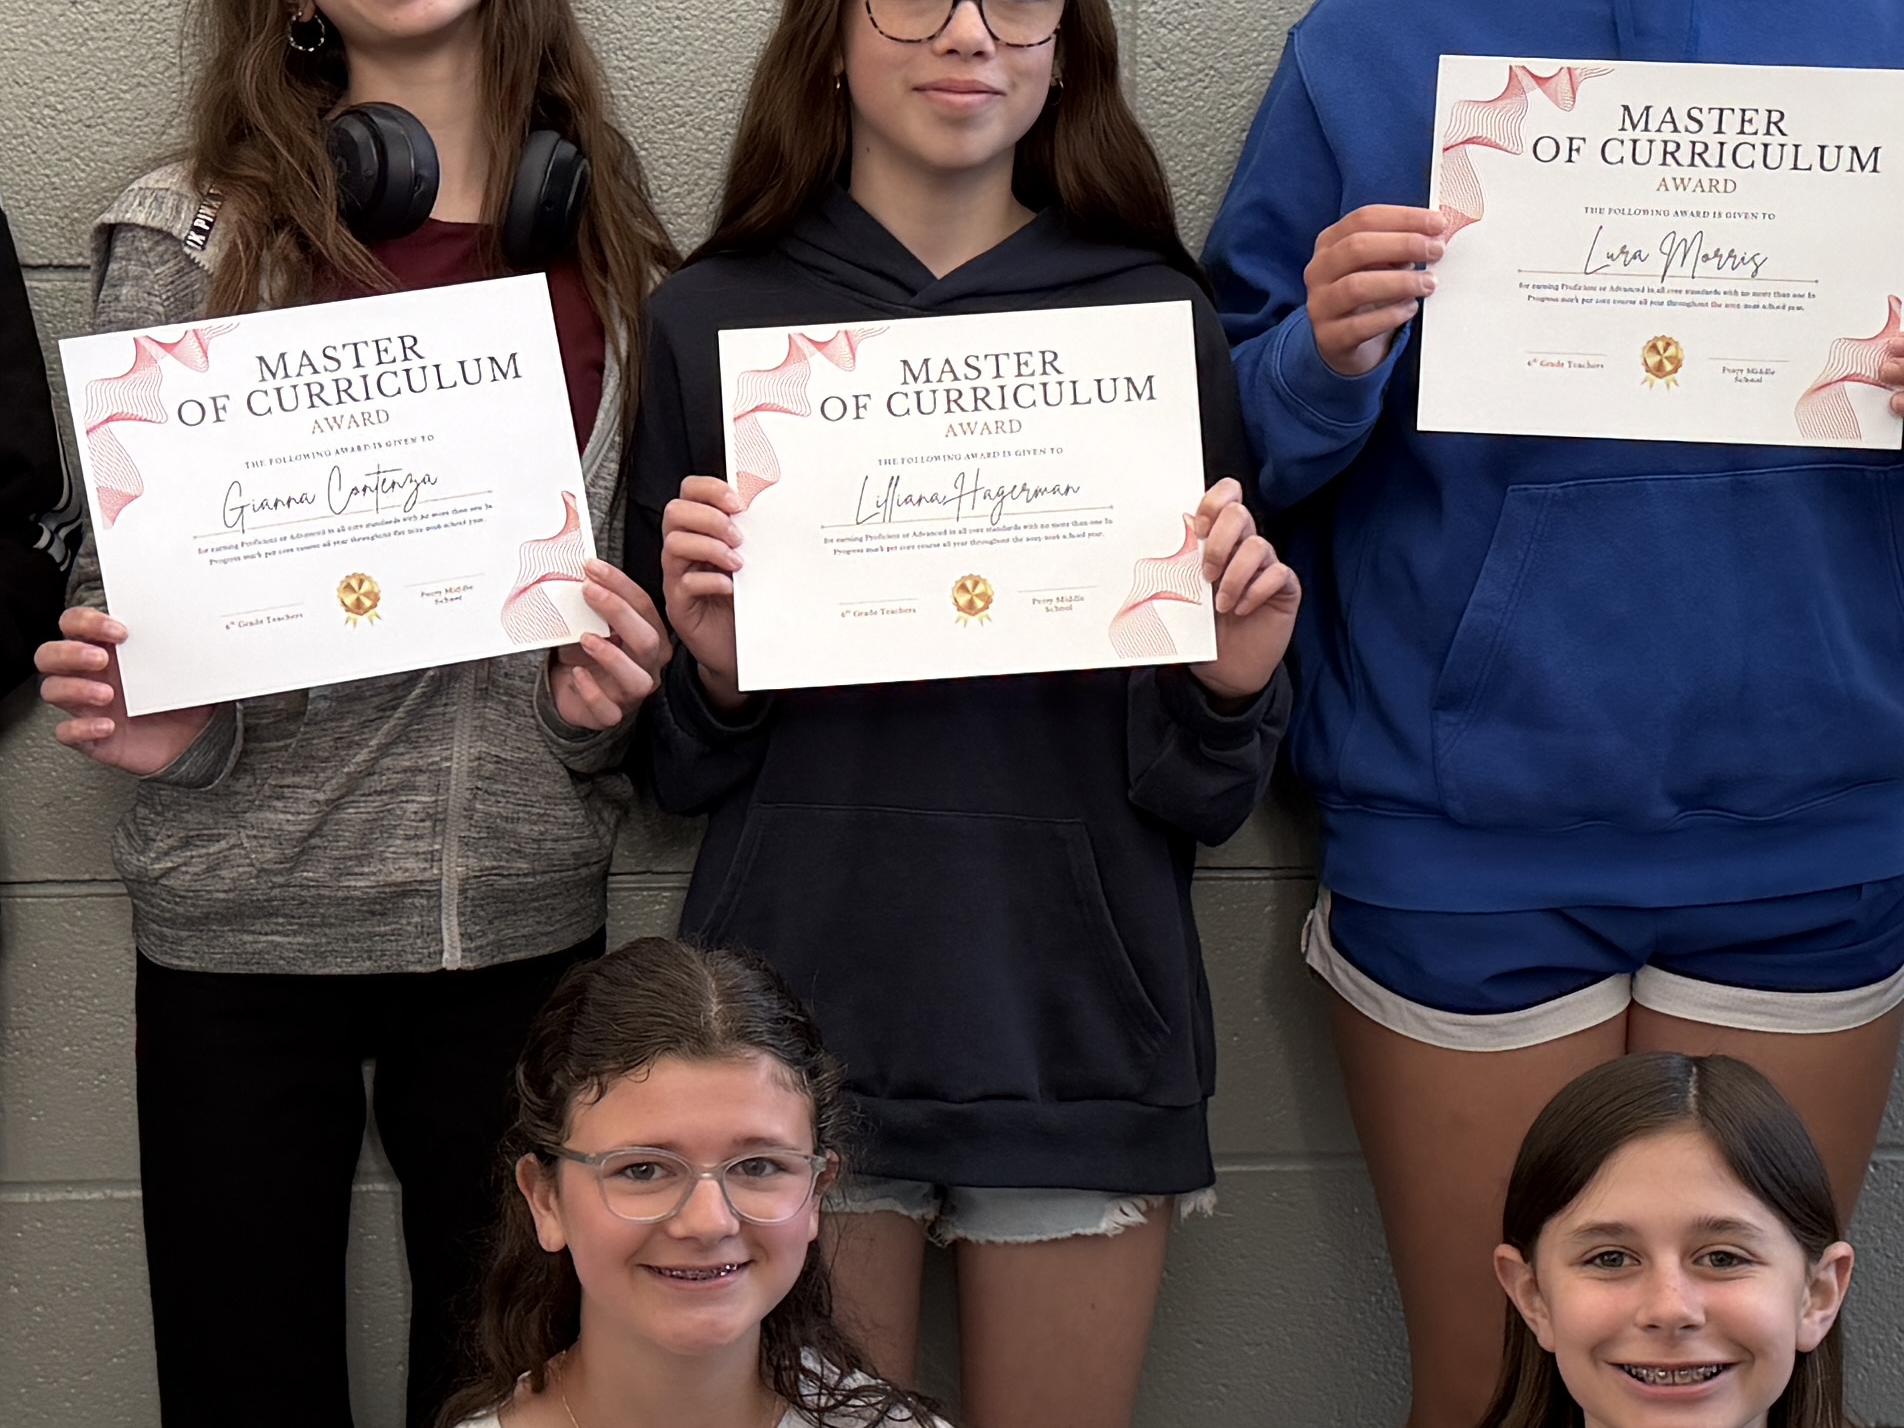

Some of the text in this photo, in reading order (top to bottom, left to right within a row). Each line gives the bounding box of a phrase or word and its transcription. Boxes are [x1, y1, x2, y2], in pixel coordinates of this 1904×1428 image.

[1618, 104, 1787, 136] MASTER
[1532, 136, 1881, 173] OF CURRICULUM
[1656, 177, 1736, 193] AWARD
[1658, 230, 1768, 284] Morris
[256, 335, 424, 381] MASTER
[900, 350, 1063, 385] MASTER
[177, 352, 521, 426] OF CURRICULUM
[820, 375, 1155, 421] OF CURRICULUM
[312, 409, 389, 433] AWARD
[945, 419, 1021, 437] AWARD
[222, 480, 316, 534] Gianna
[855, 474, 946, 526] Lilliana
